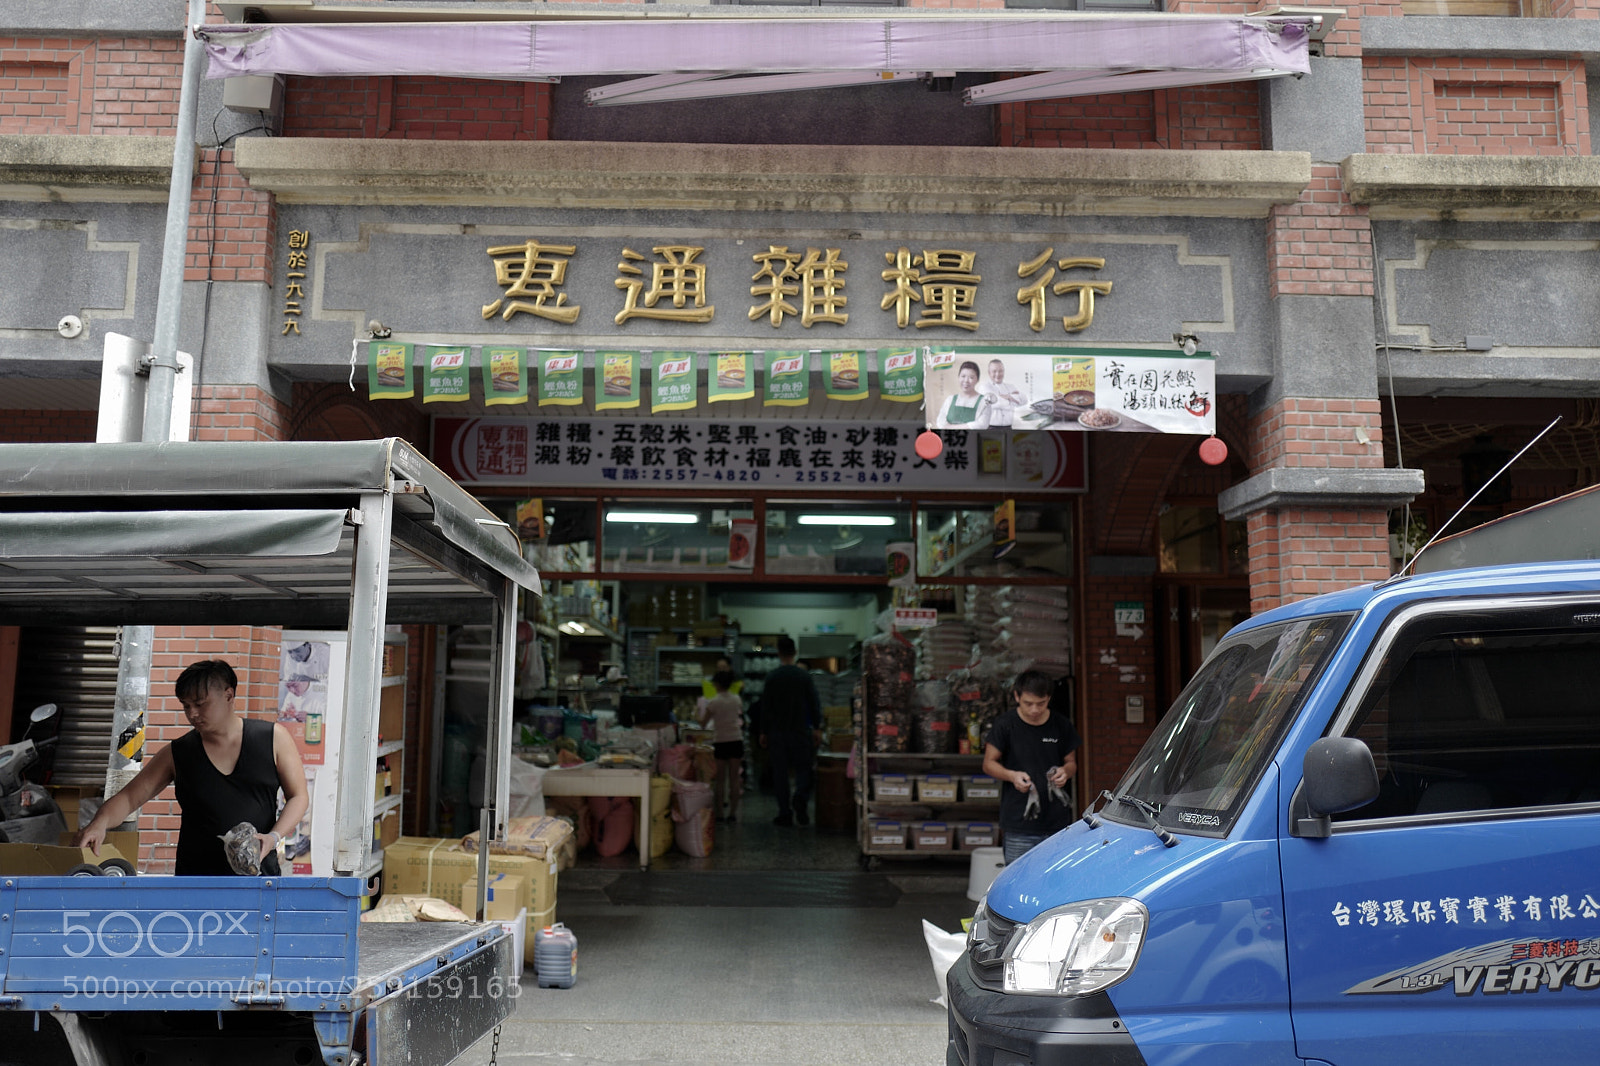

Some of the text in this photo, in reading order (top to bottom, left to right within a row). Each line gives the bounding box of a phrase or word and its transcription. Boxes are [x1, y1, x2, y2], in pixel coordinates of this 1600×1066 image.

[282, 229, 309, 335] 創於一九二九
[482, 239, 1113, 333] 惠通雜糧行
[1117, 611, 1143, 622] 173
[1178, 812, 1220, 826] VERYCA
[1511, 939, 1579, 960] 三菱科技
[1400, 973, 1447, 988] 1.3L
